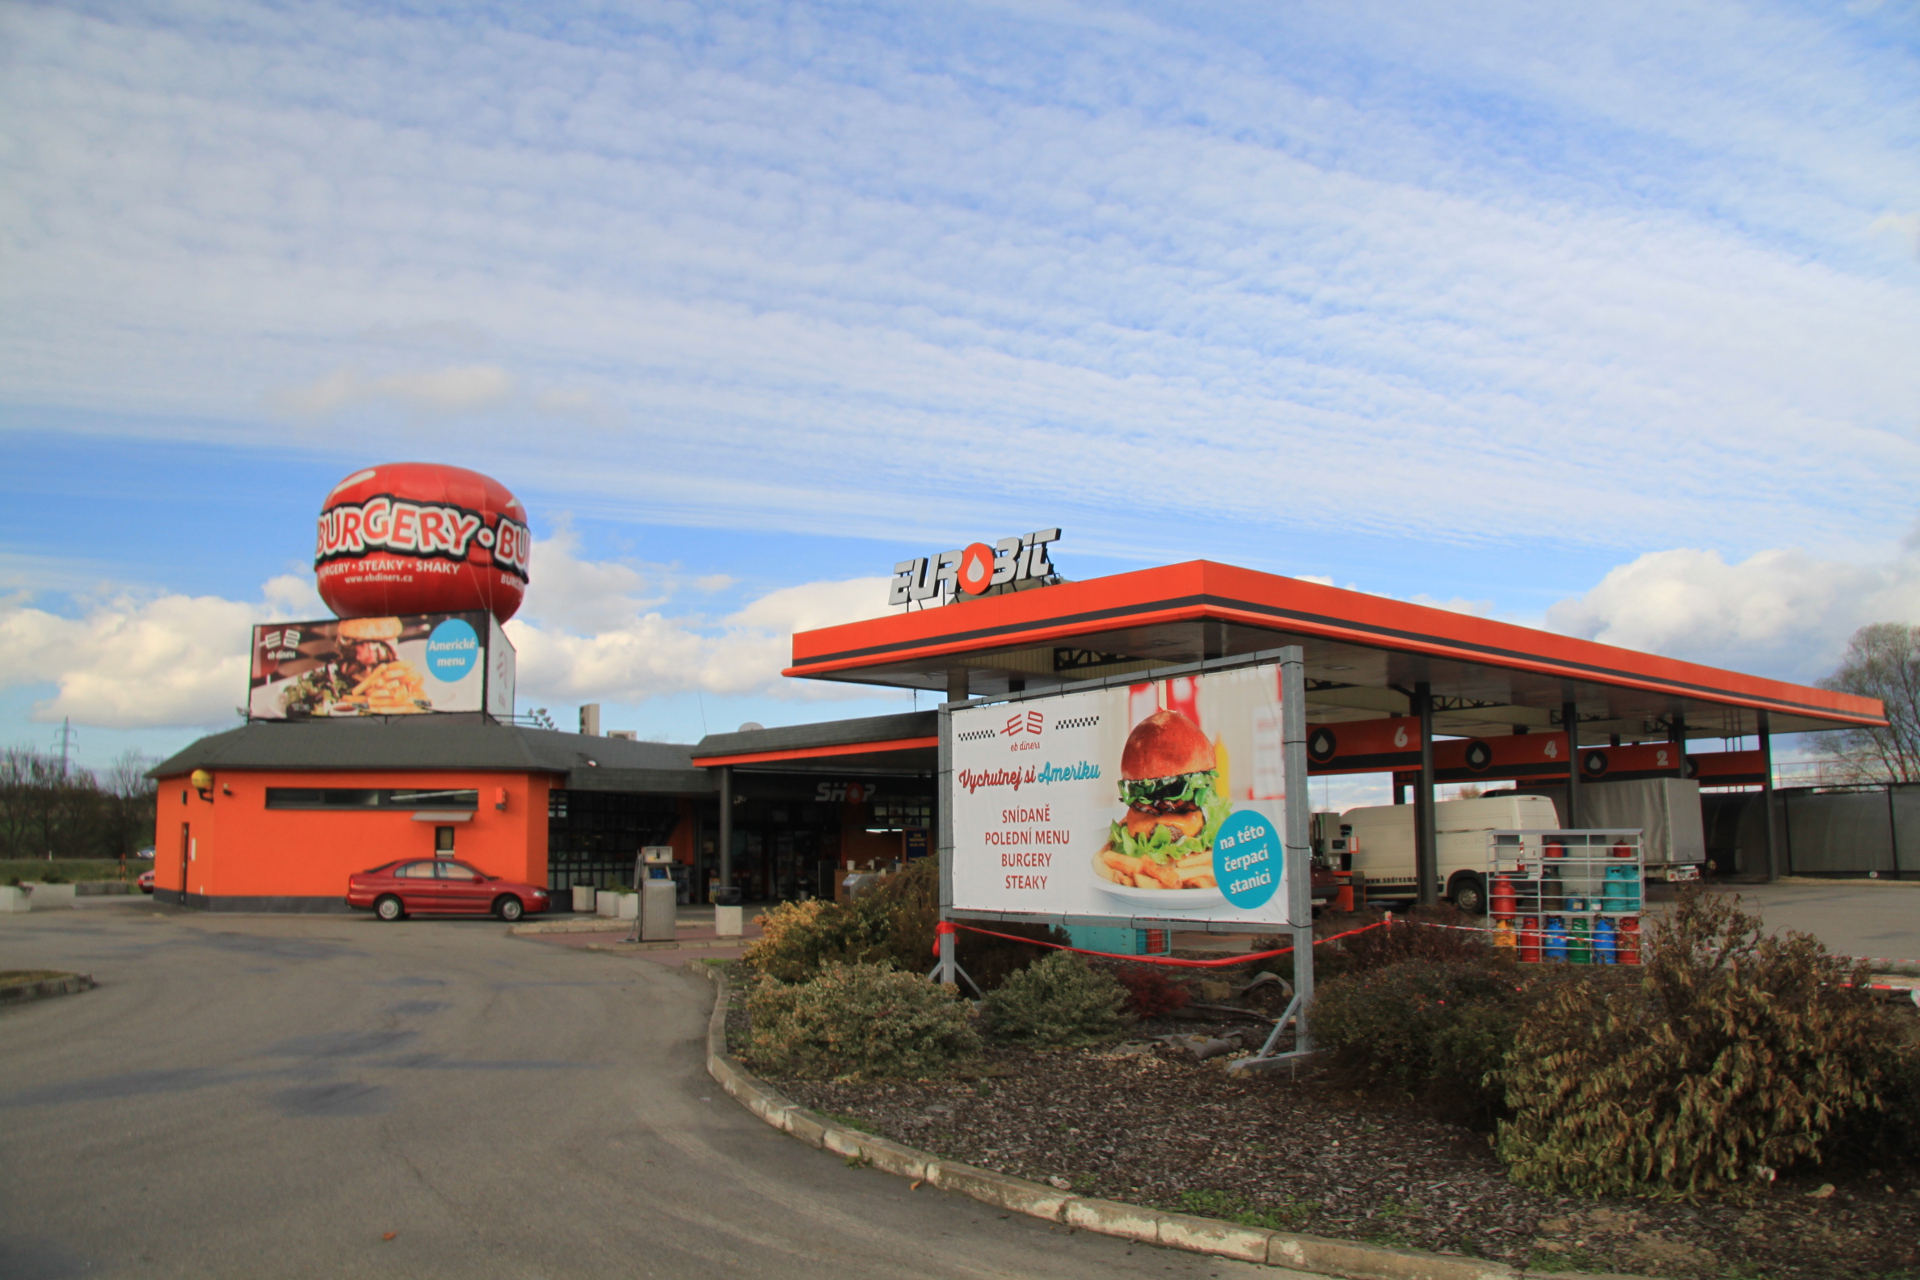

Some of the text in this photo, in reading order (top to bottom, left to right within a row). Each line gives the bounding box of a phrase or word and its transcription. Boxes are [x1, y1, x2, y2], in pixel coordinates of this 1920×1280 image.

[316, 497, 481, 556] BURGERY
[496, 518, 531, 569] BU
[358, 559, 405, 572] STEAKY
[416, 562, 460, 575] SHAKY
[428, 640, 476, 652] Americké
[437, 657, 466, 668] menu
[1394, 726, 1408, 748] 6
[1544, 741, 1557, 758] 4
[1656, 750, 1669, 766] 2
[958, 761, 1101, 794] Vychutnej si Ameriku
[1002, 803, 1051, 823] SNÍDANĚ
[985, 827, 1070, 845] POLEDNÍ MENU
[1220, 825, 1265, 850] na této
[1001, 853, 1052, 867] BURGERY
[1224, 843, 1269, 872] čerpací
[1005, 875, 1048, 889] STEAKY
[1230, 868, 1271, 895] stanici
